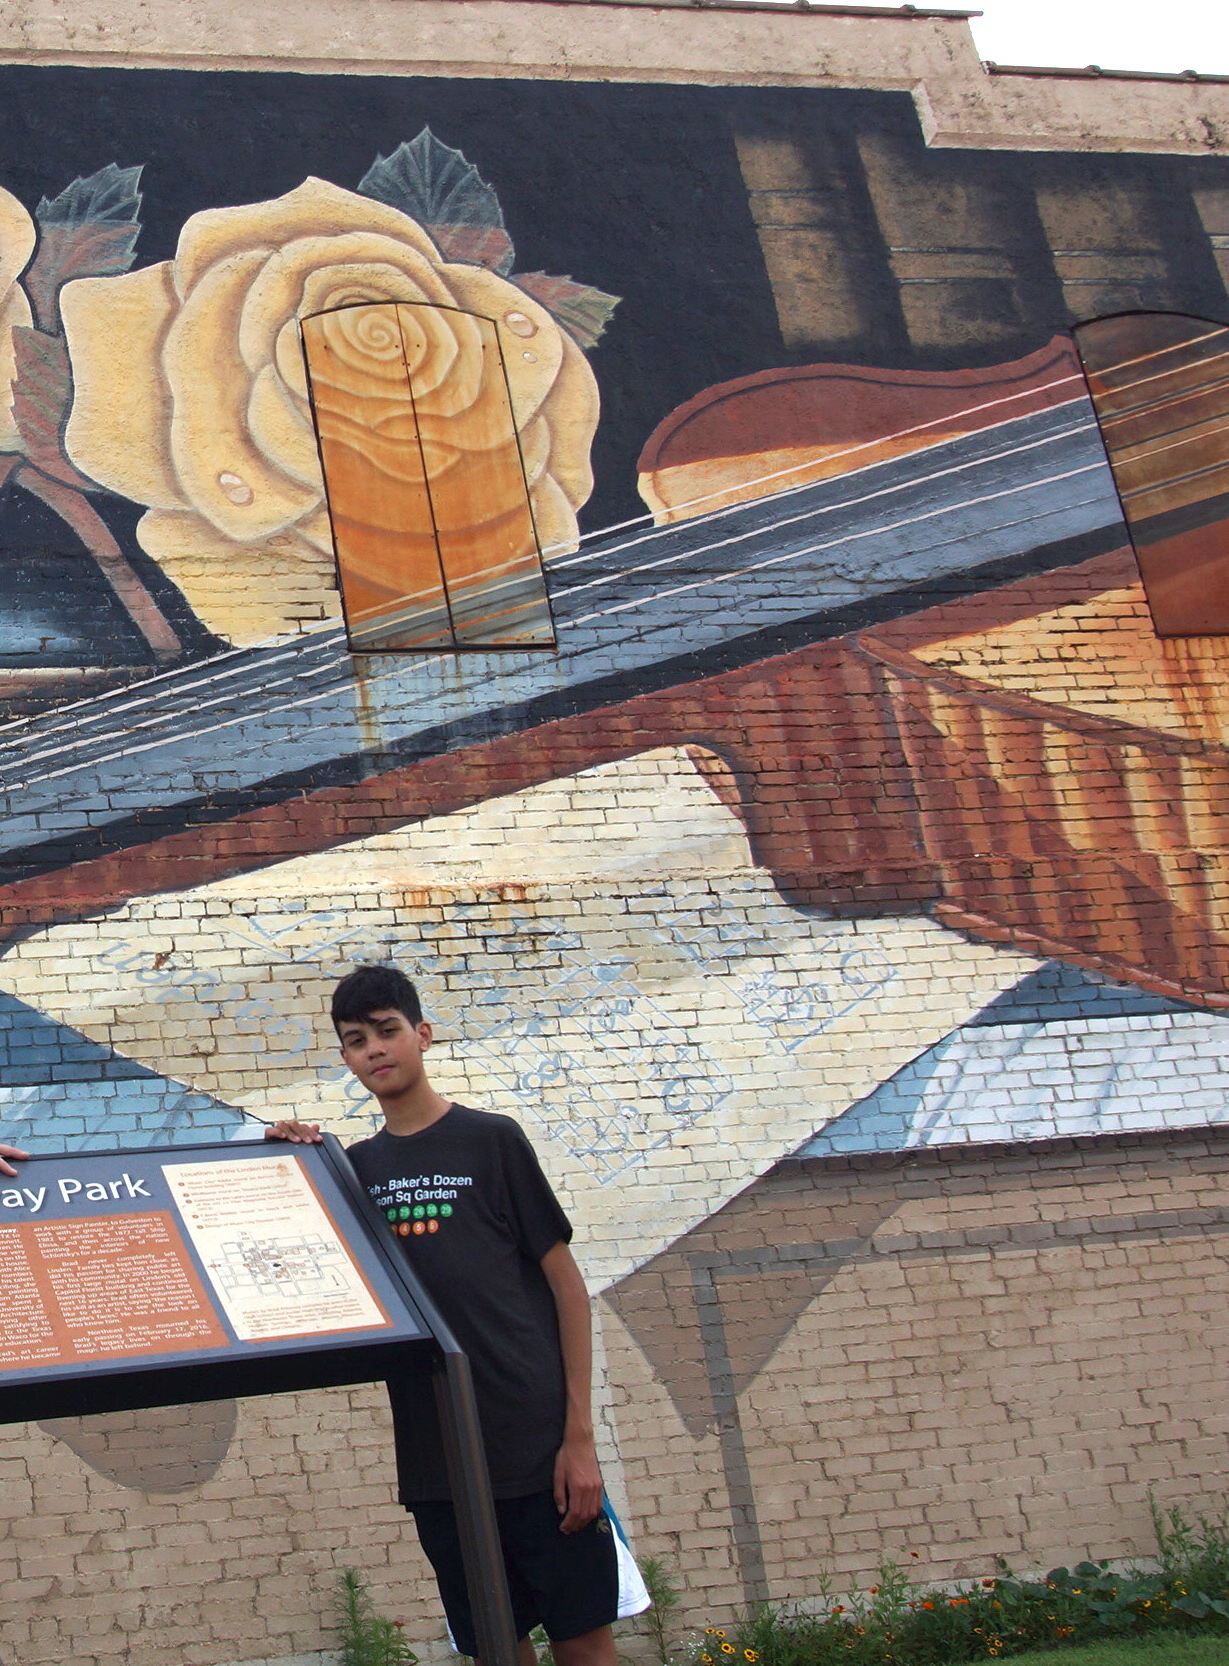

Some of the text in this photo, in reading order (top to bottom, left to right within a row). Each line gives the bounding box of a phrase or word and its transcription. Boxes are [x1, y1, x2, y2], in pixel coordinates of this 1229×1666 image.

[57, 1173, 152, 1203] Park
[388, 1175, 430, 1191] Baker's
[433, 1174, 473, 1186] Dozen
[396, 1191, 411, 1204] Sq
[414, 1188, 457, 1201] Garden
